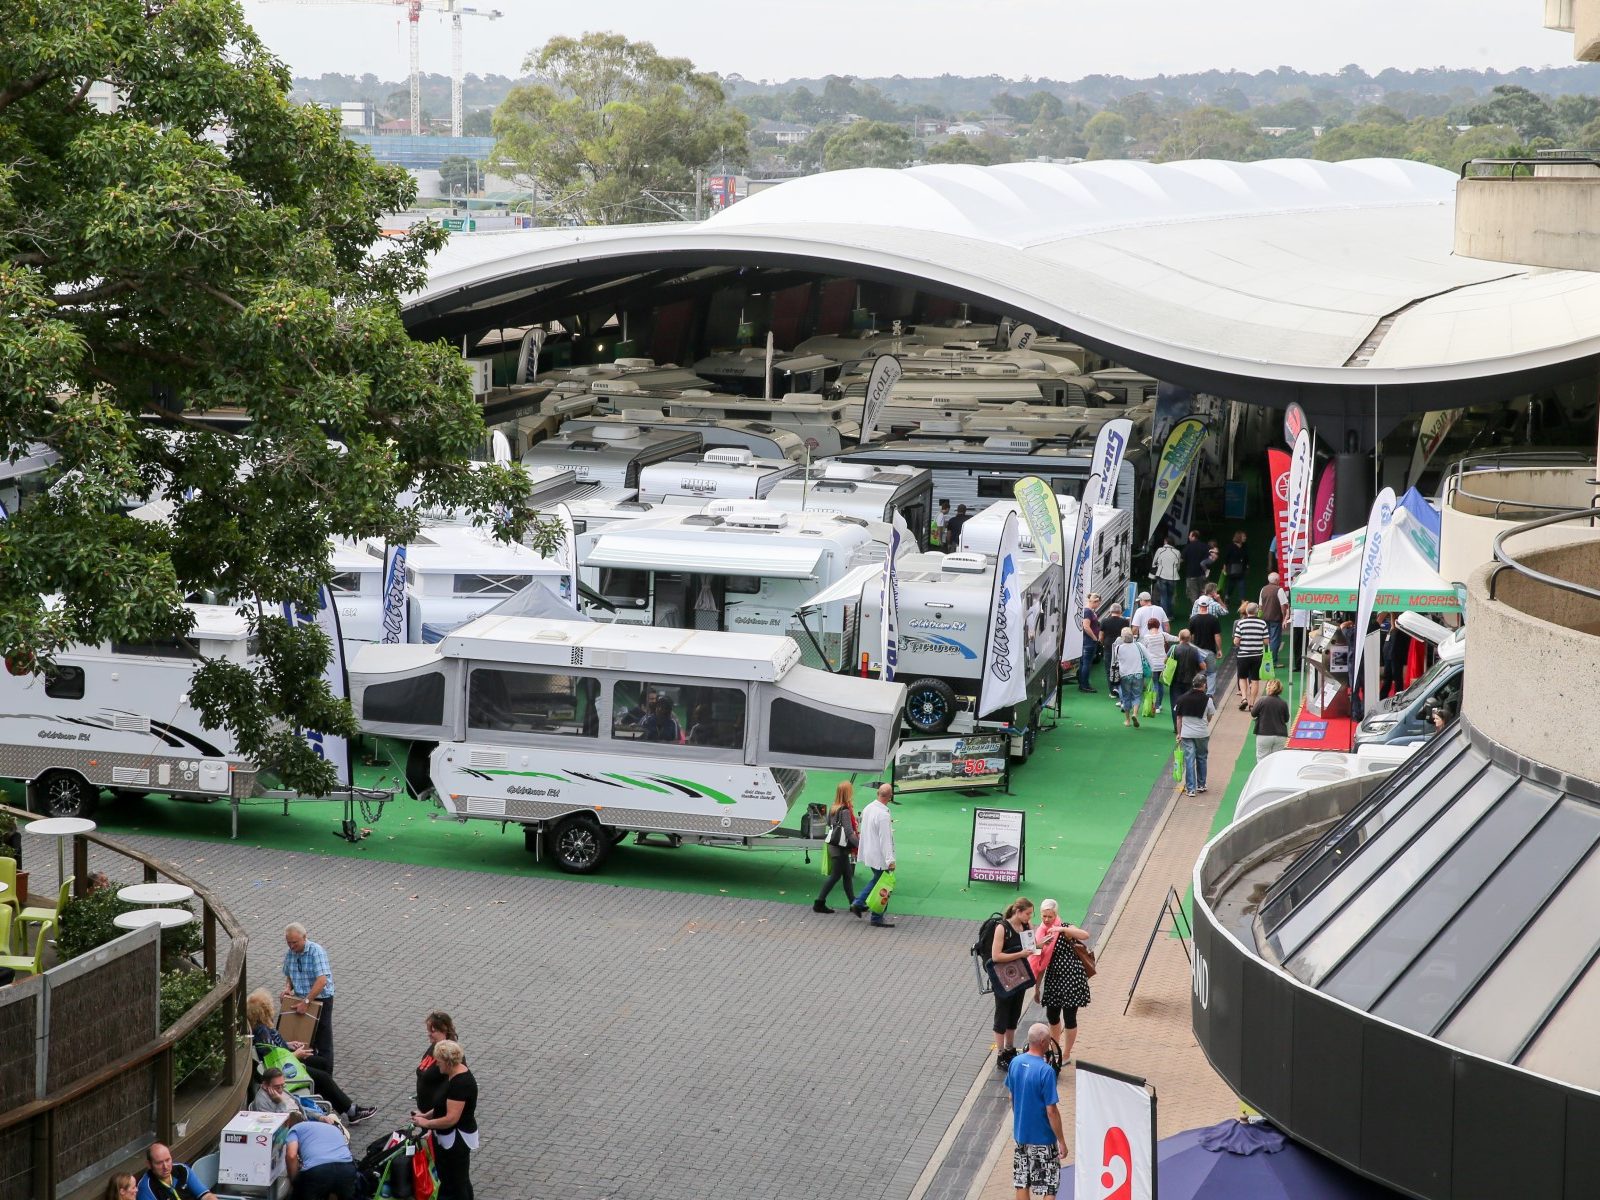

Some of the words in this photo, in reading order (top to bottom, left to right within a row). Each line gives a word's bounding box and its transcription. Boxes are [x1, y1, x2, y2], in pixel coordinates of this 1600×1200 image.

[873, 366, 891, 401] GOLF
[681, 478, 717, 491] RIVER
[1362, 531, 1382, 588] KNAUS
[1296, 593, 1340, 605] NOWRA
[1349, 594, 1400, 606] PRITH
[908, 618, 950, 630] Goldstream
[965, 759, 985, 773] 50
[996, 875, 1017, 883] HERE
